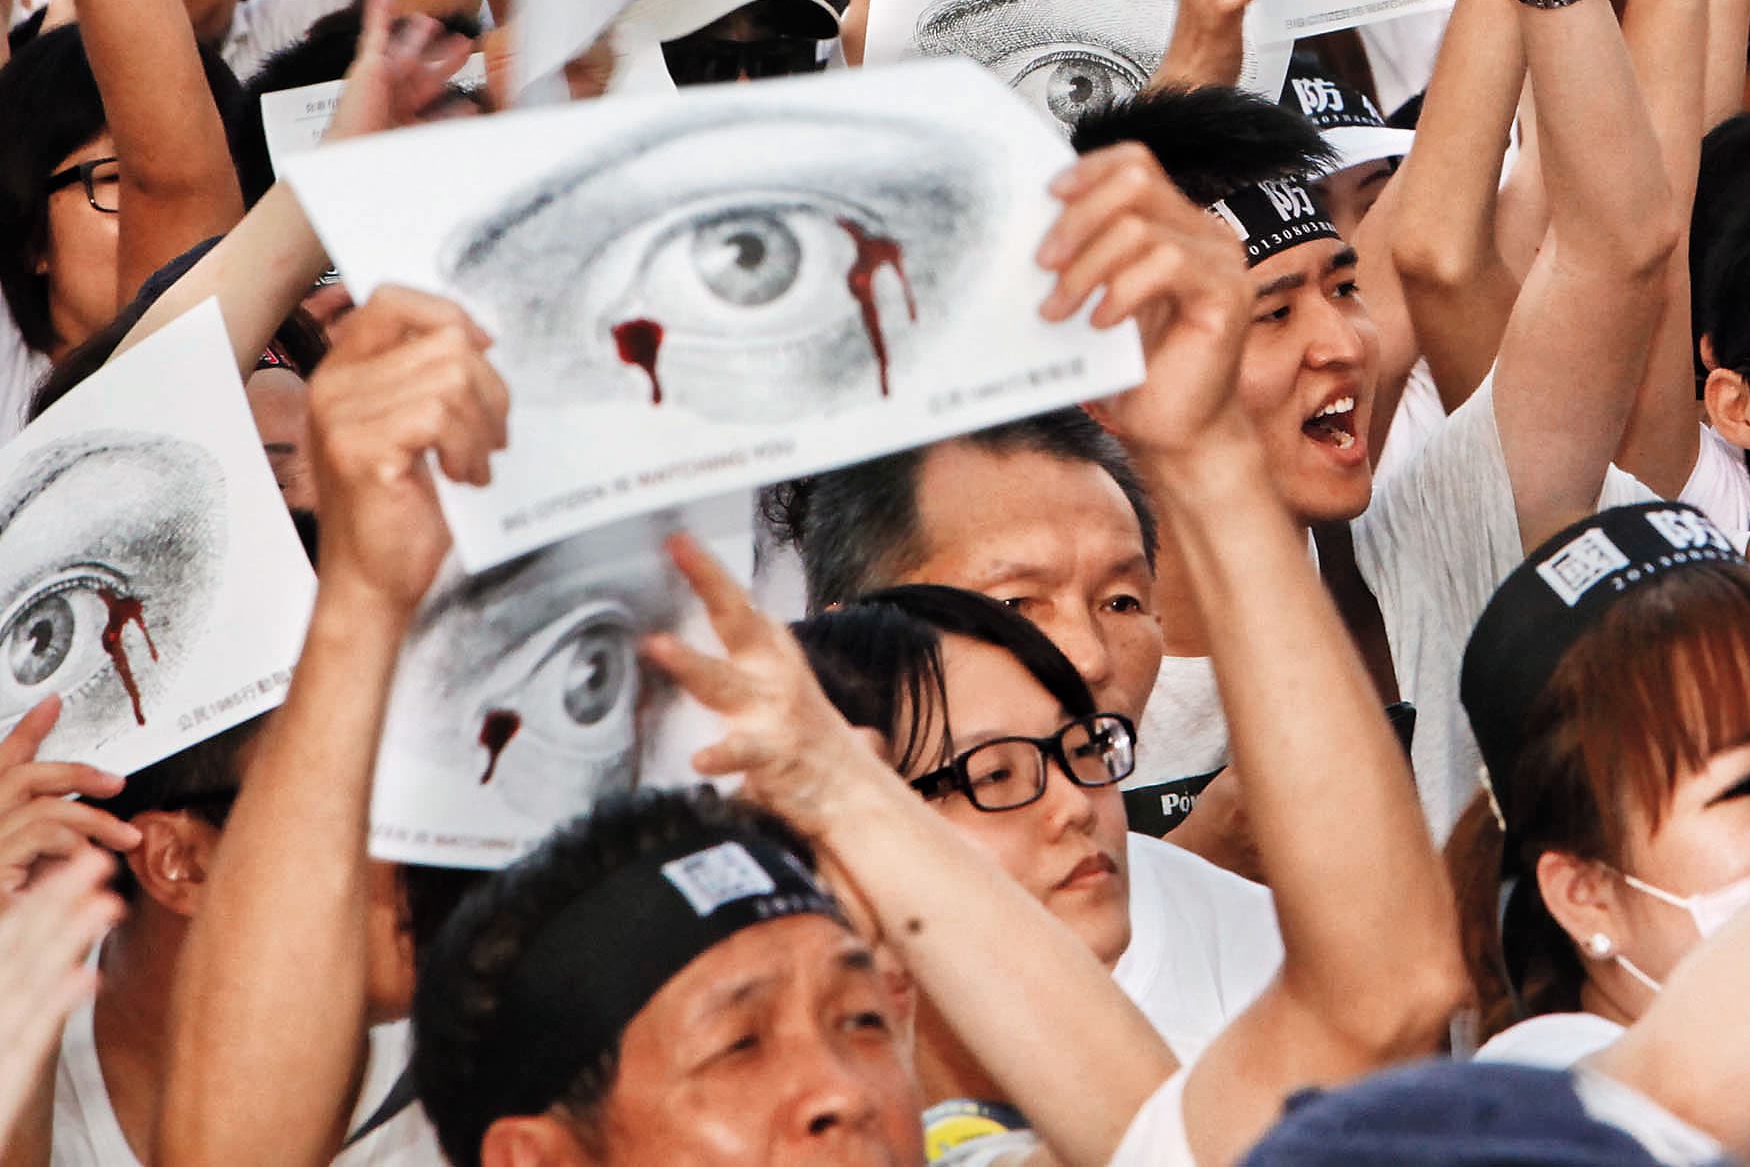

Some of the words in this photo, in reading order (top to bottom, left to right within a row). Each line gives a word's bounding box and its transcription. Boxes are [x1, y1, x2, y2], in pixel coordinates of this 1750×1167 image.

[178, 669, 291, 731] 公民1985行動聯
